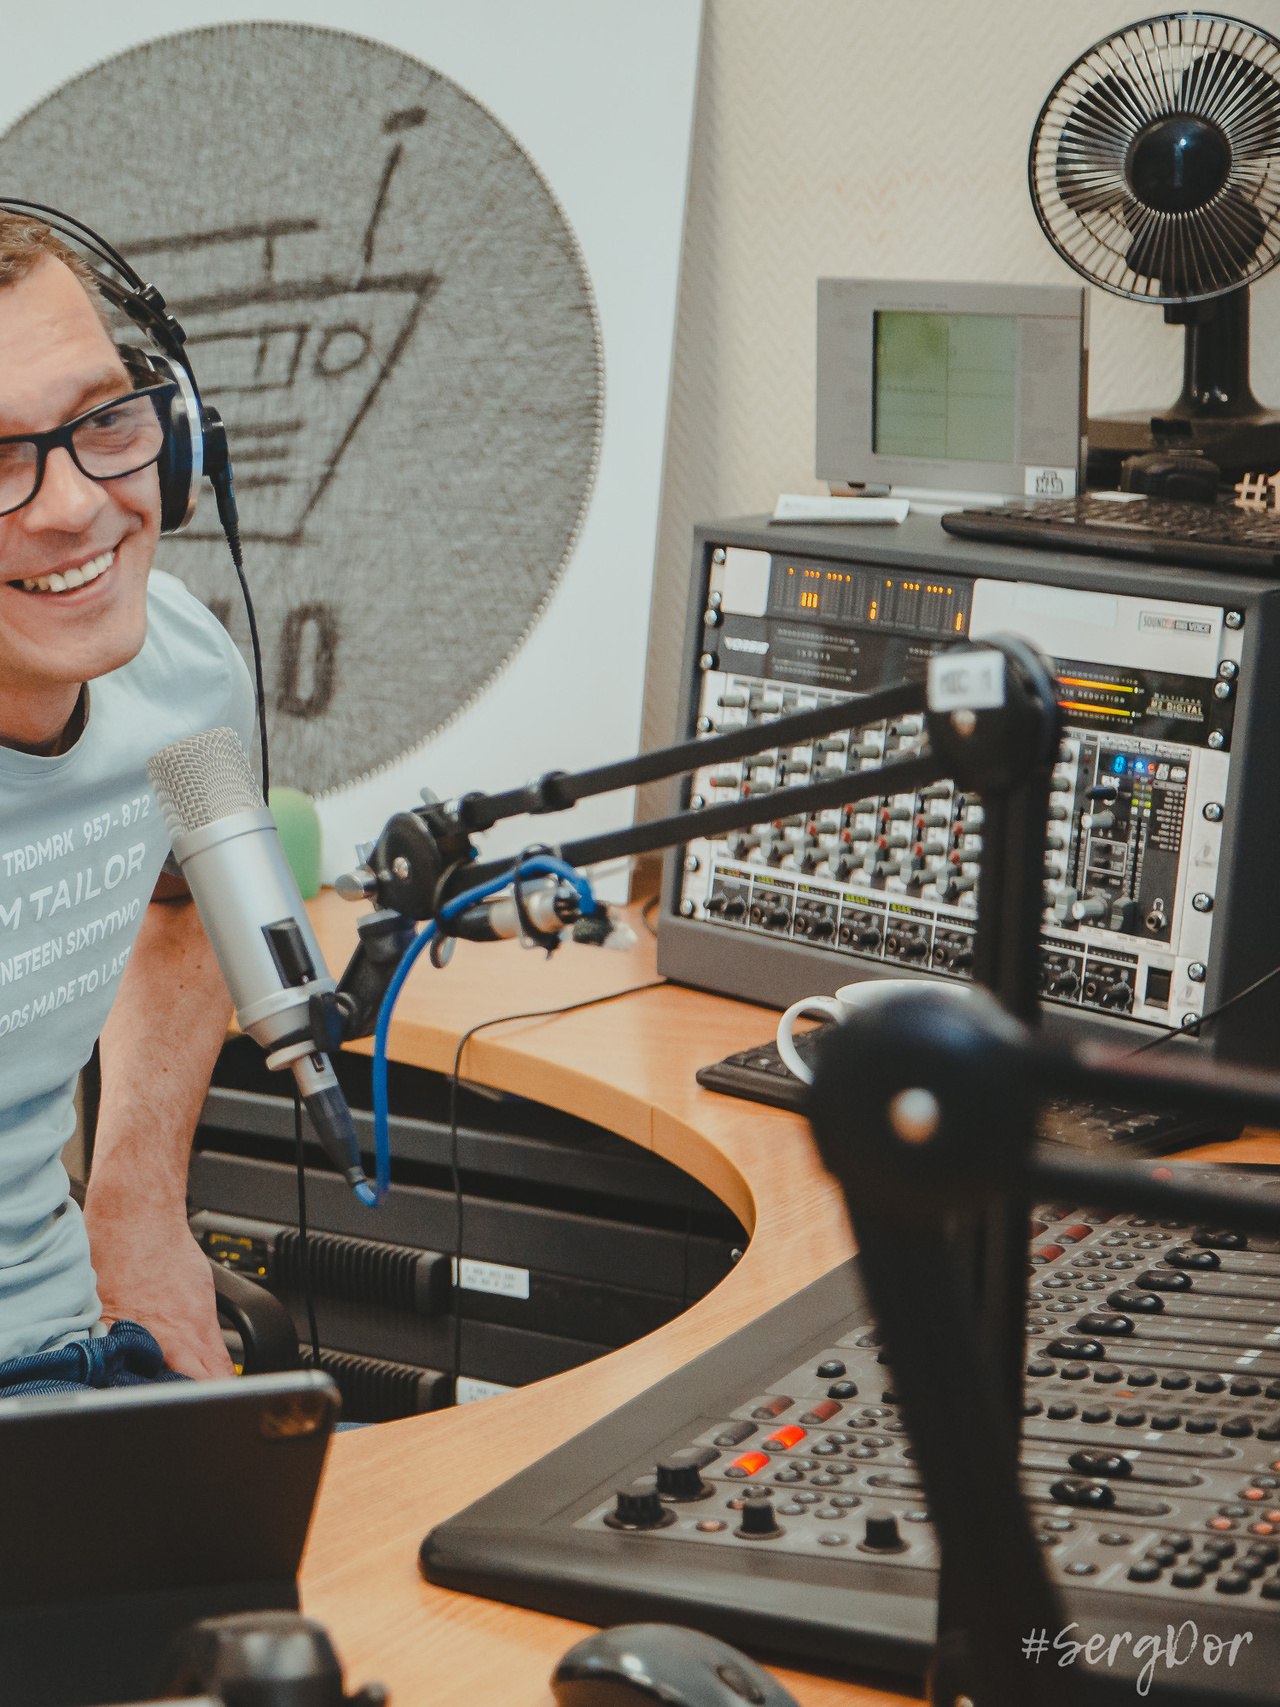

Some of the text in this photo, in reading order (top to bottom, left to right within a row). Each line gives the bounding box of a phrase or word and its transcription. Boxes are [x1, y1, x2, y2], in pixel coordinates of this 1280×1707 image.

[1166, 701, 1203, 715] DIGITAL
[2, 828, 74, 878] TRDMRK
[82, 794, 150, 846] 957-872
[28, 842, 146, 921] TAILOR
[65, 897, 141, 955] SIXTYTWO
[30, 979, 76, 1022] MADE
[78, 969, 99, 997] TO
